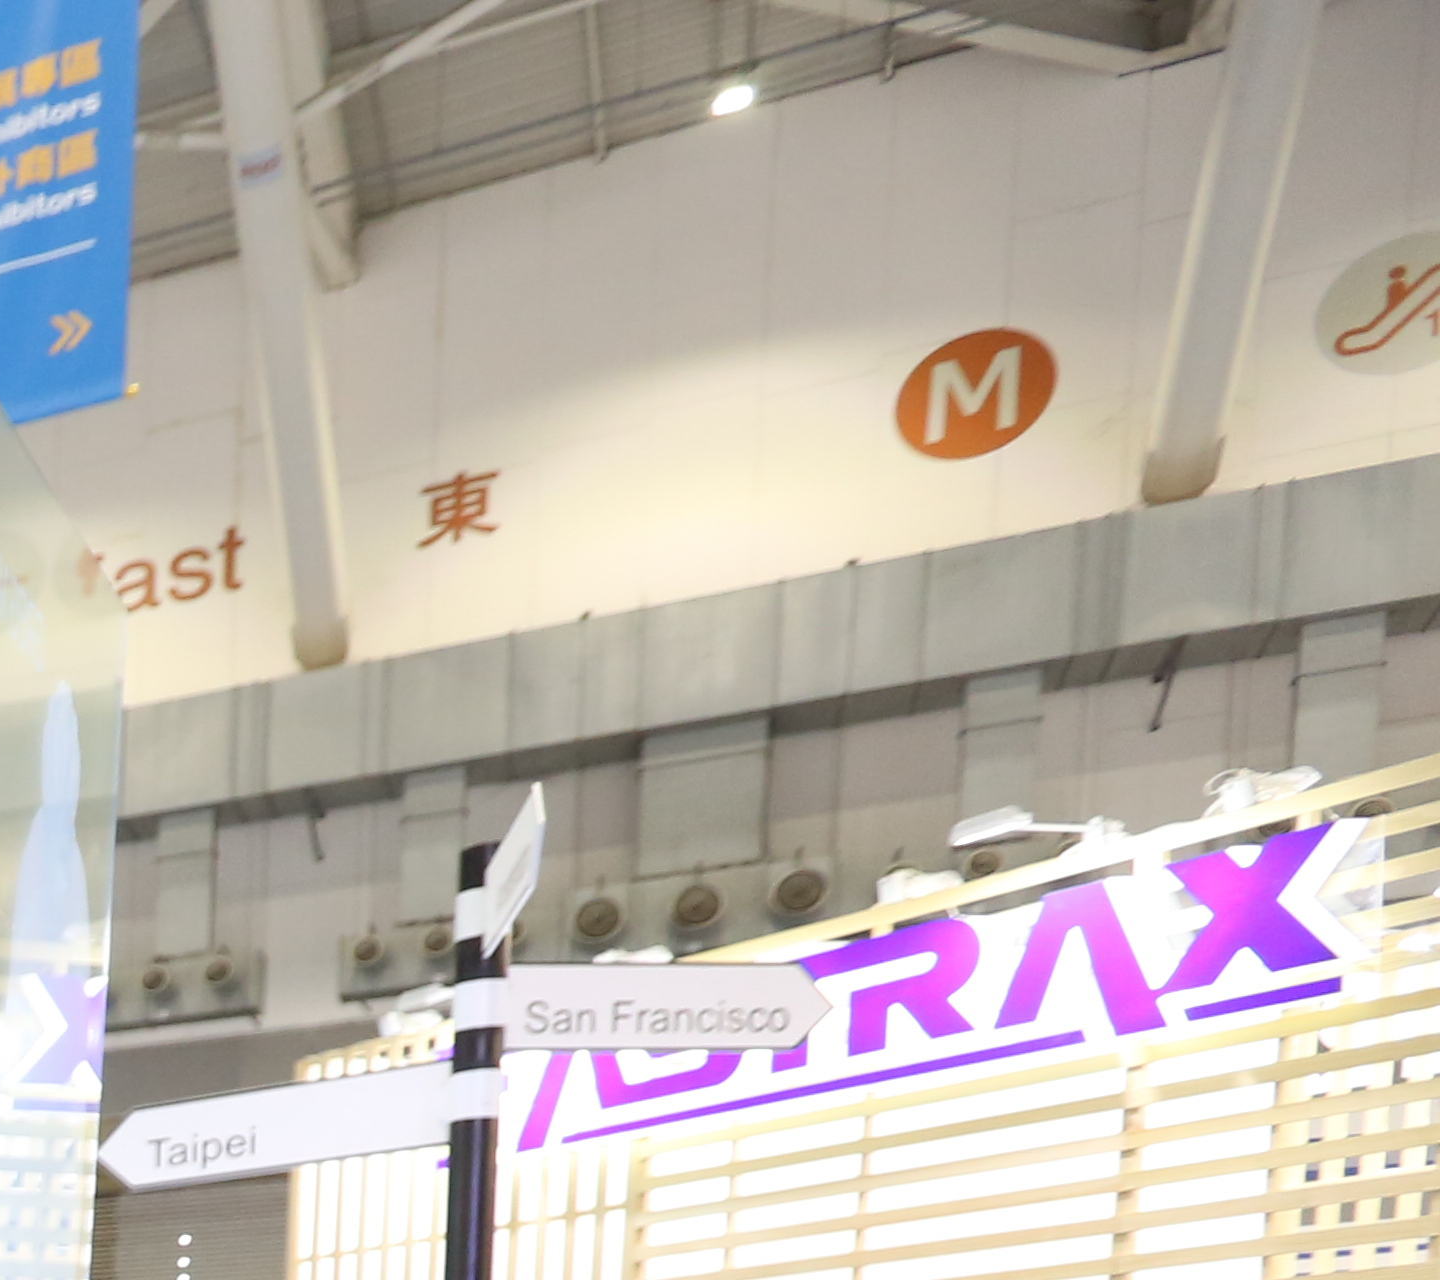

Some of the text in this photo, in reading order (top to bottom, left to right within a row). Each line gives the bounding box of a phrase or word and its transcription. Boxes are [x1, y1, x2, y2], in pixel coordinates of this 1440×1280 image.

[924, 347, 1022, 446] M
[418, 470, 500, 549] 東
[115, 525, 246, 613] ast
[524, 999, 792, 1036] San Francisco
[149, 1127, 258, 1170] Taipei
